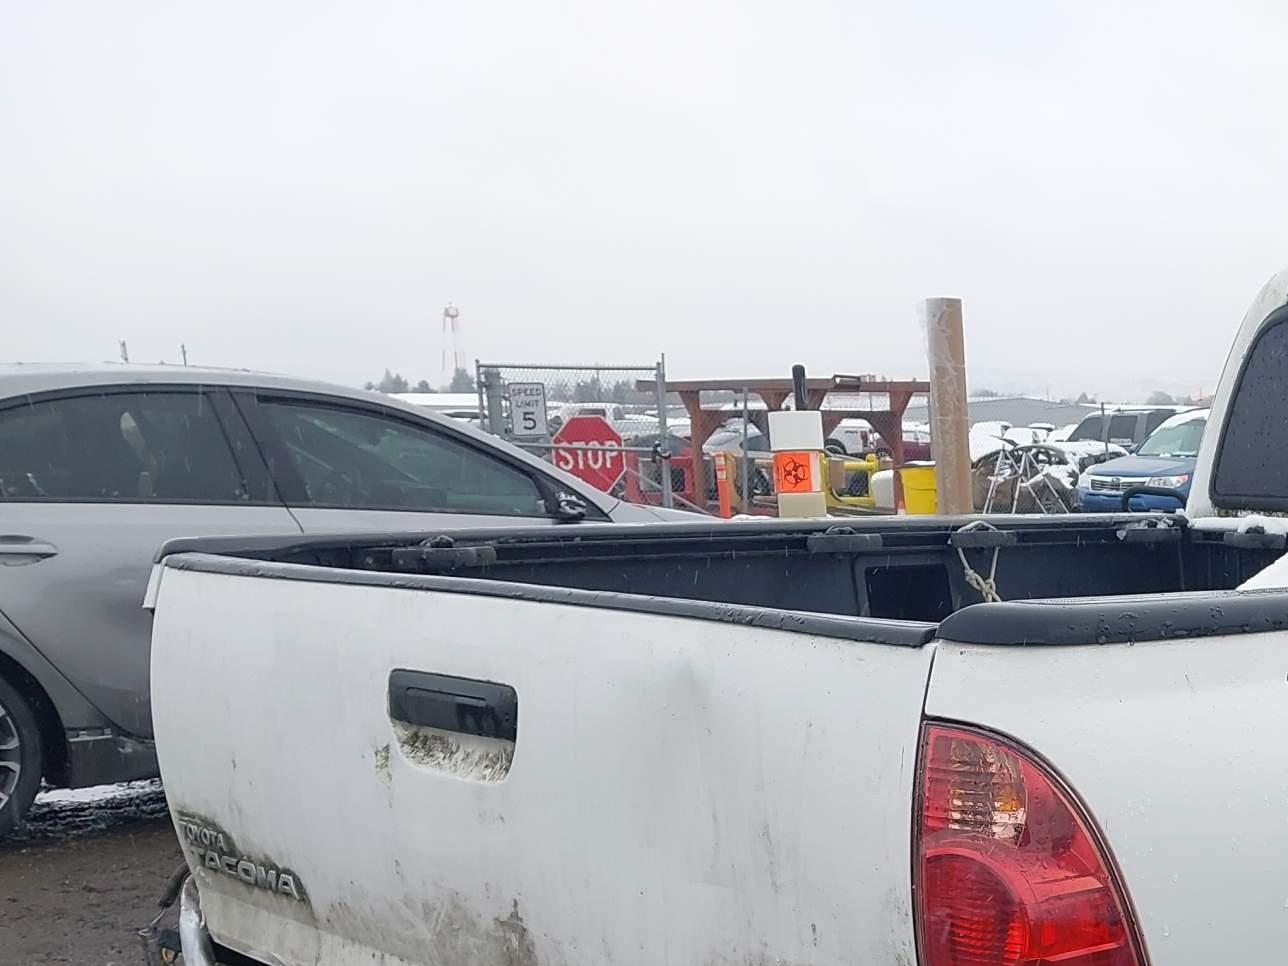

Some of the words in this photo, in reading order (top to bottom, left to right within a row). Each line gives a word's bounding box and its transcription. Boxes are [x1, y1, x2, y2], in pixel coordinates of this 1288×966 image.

[511, 387, 542, 397] SPEED
[515, 399, 539, 408] LIMIT
[522, 412, 537, 431] 5
[557, 440, 618, 471] STOP
[179, 820, 227, 852] TOYOTA
[190, 846, 301, 901] TACOMA
